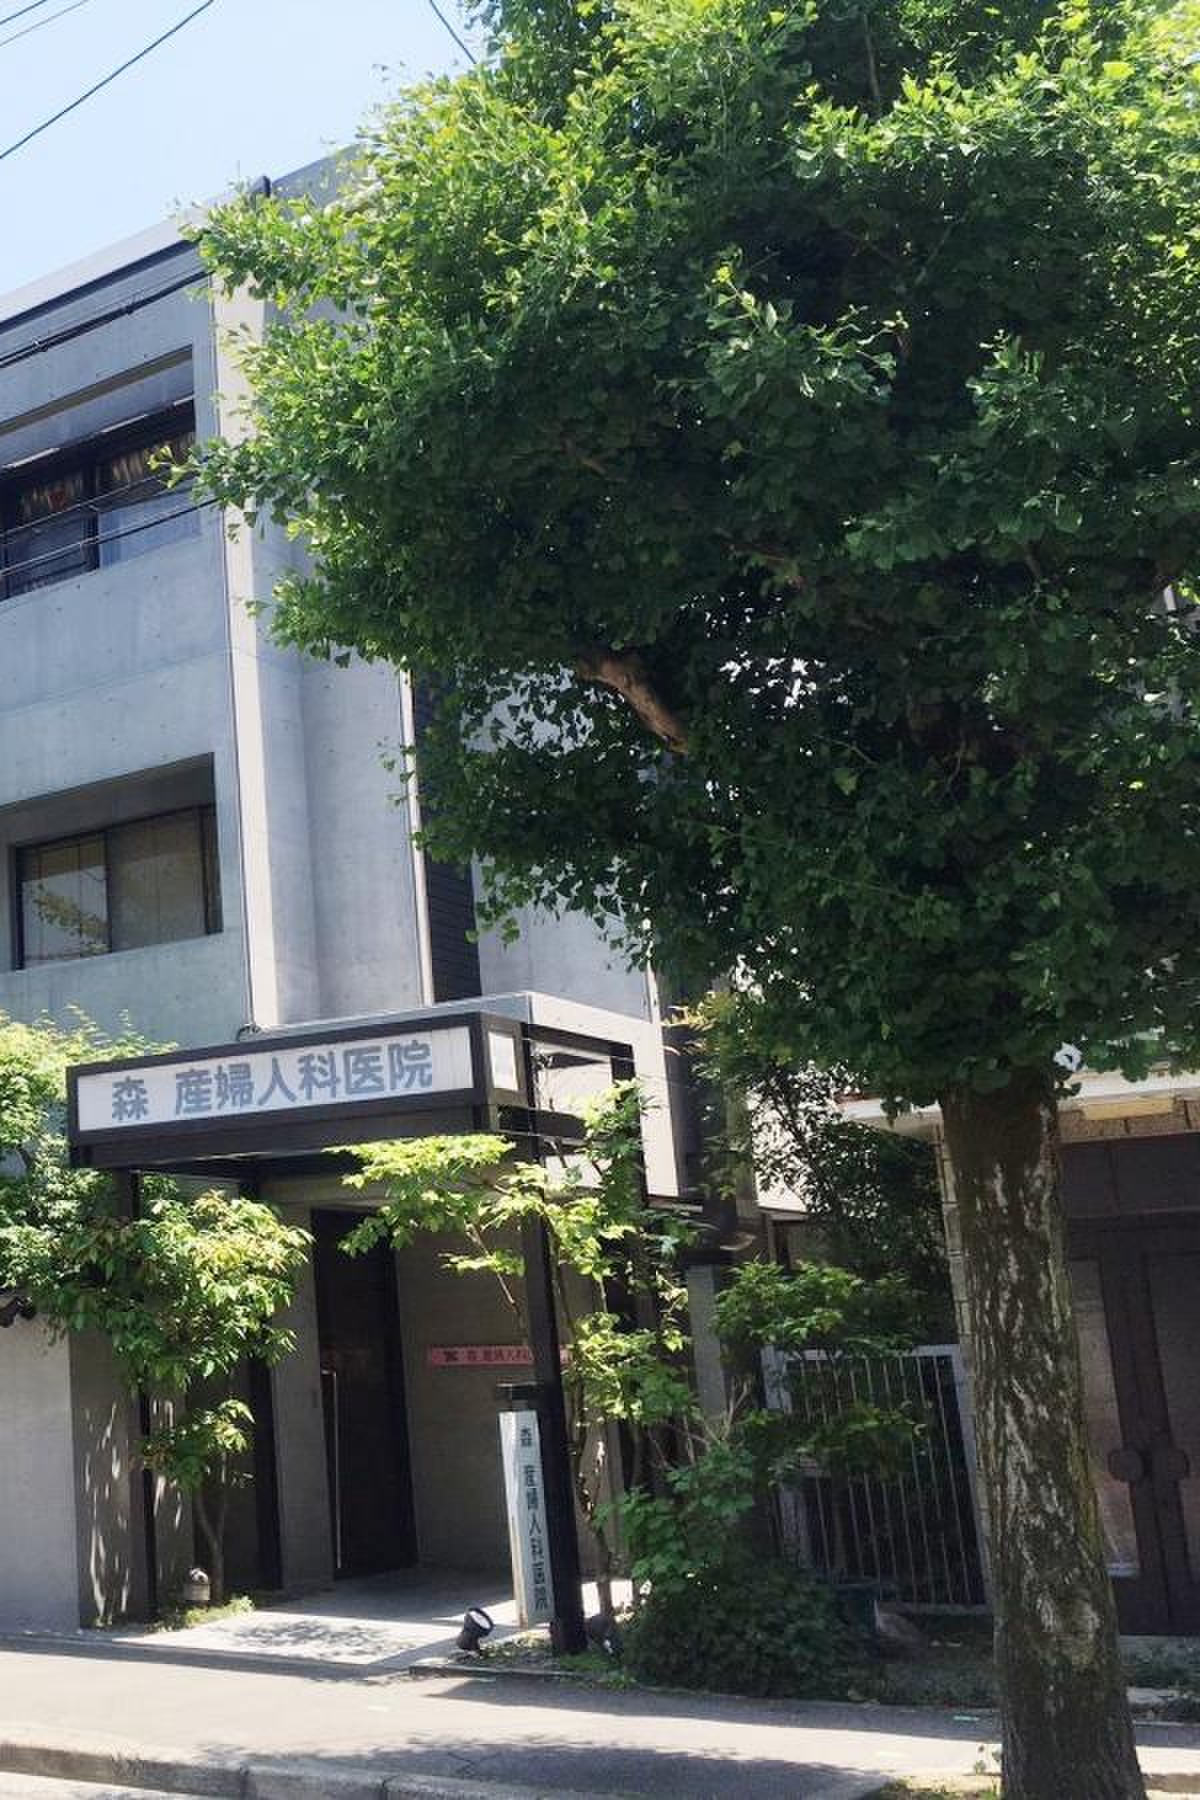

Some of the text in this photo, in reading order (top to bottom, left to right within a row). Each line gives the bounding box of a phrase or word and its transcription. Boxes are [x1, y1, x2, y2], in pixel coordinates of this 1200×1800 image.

[112, 1039, 433, 1121] 森 産婦人科医院
